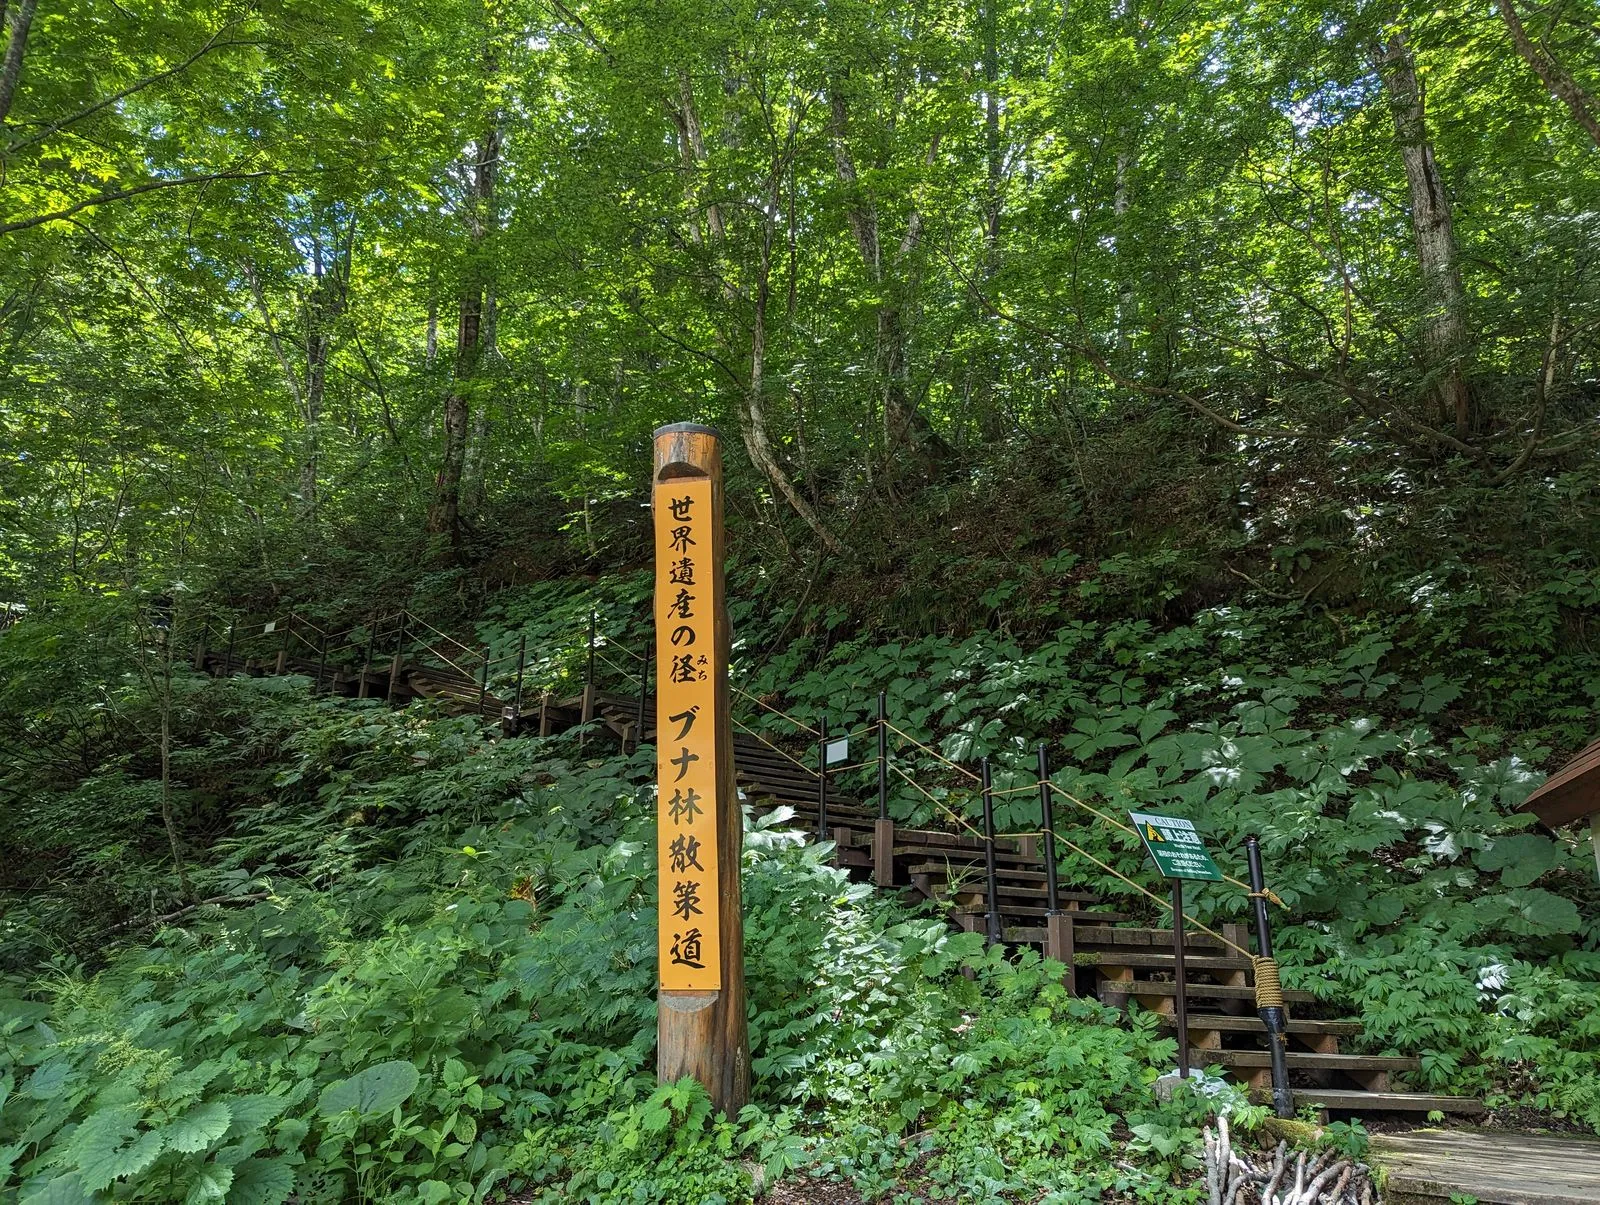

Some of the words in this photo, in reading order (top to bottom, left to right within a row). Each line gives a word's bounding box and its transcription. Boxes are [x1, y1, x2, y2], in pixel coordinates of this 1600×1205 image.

[668, 495, 697, 683] 世界遺産の径
[696, 654, 708, 681] みち
[1154, 817, 1193, 829] CAUTION
[1160, 828, 1202, 845] 頭上注意
[668, 705, 706, 969] ブナ林散策道
